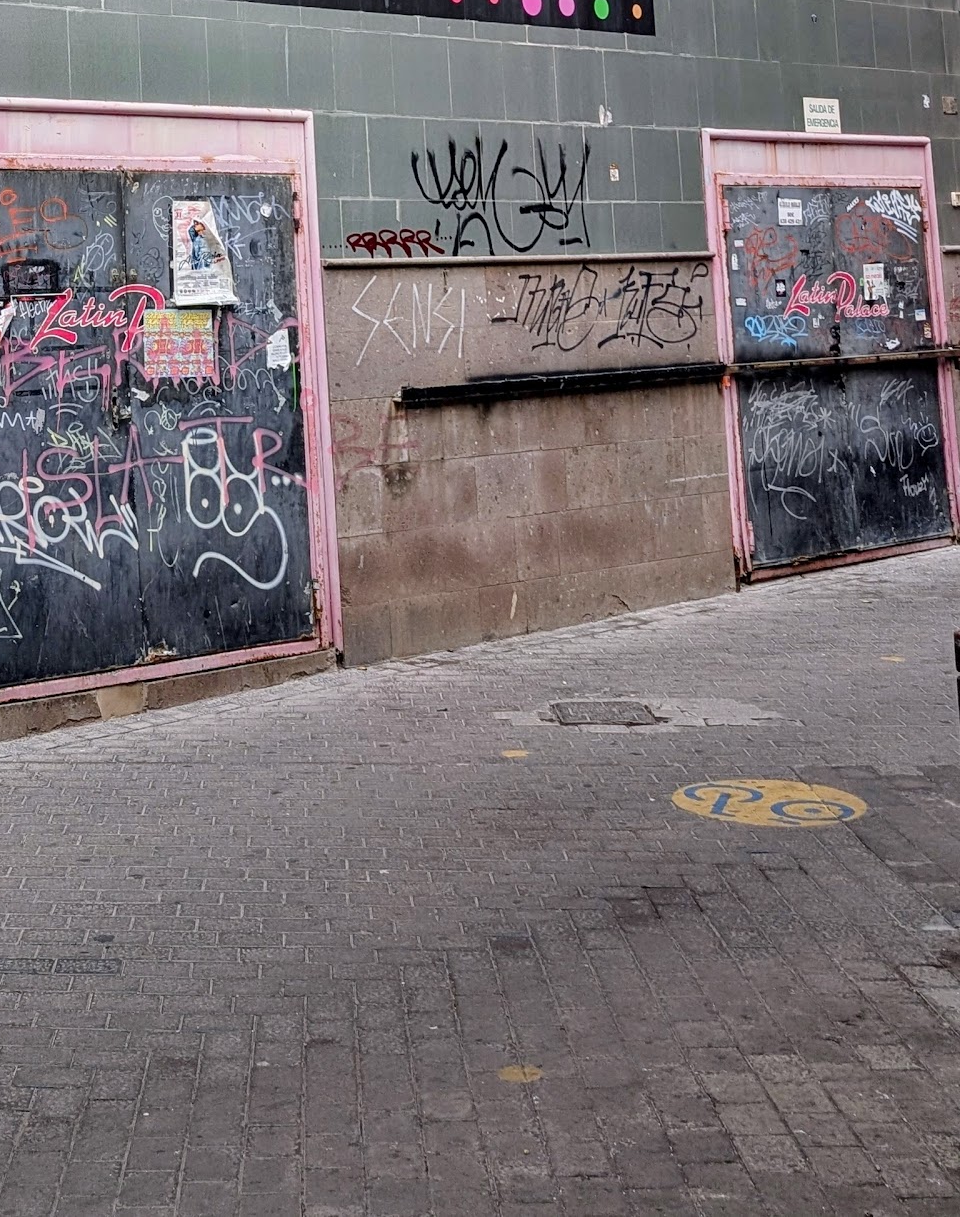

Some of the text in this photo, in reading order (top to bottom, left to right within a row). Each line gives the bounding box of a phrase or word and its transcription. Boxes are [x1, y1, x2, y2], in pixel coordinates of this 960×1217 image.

[806, 117, 839, 128] EMERGENCIA
[809, 103, 836, 115] SALIDA DE
[783, 271, 890, 322] Latin Palace
[30, 288, 127, 349] Latin
